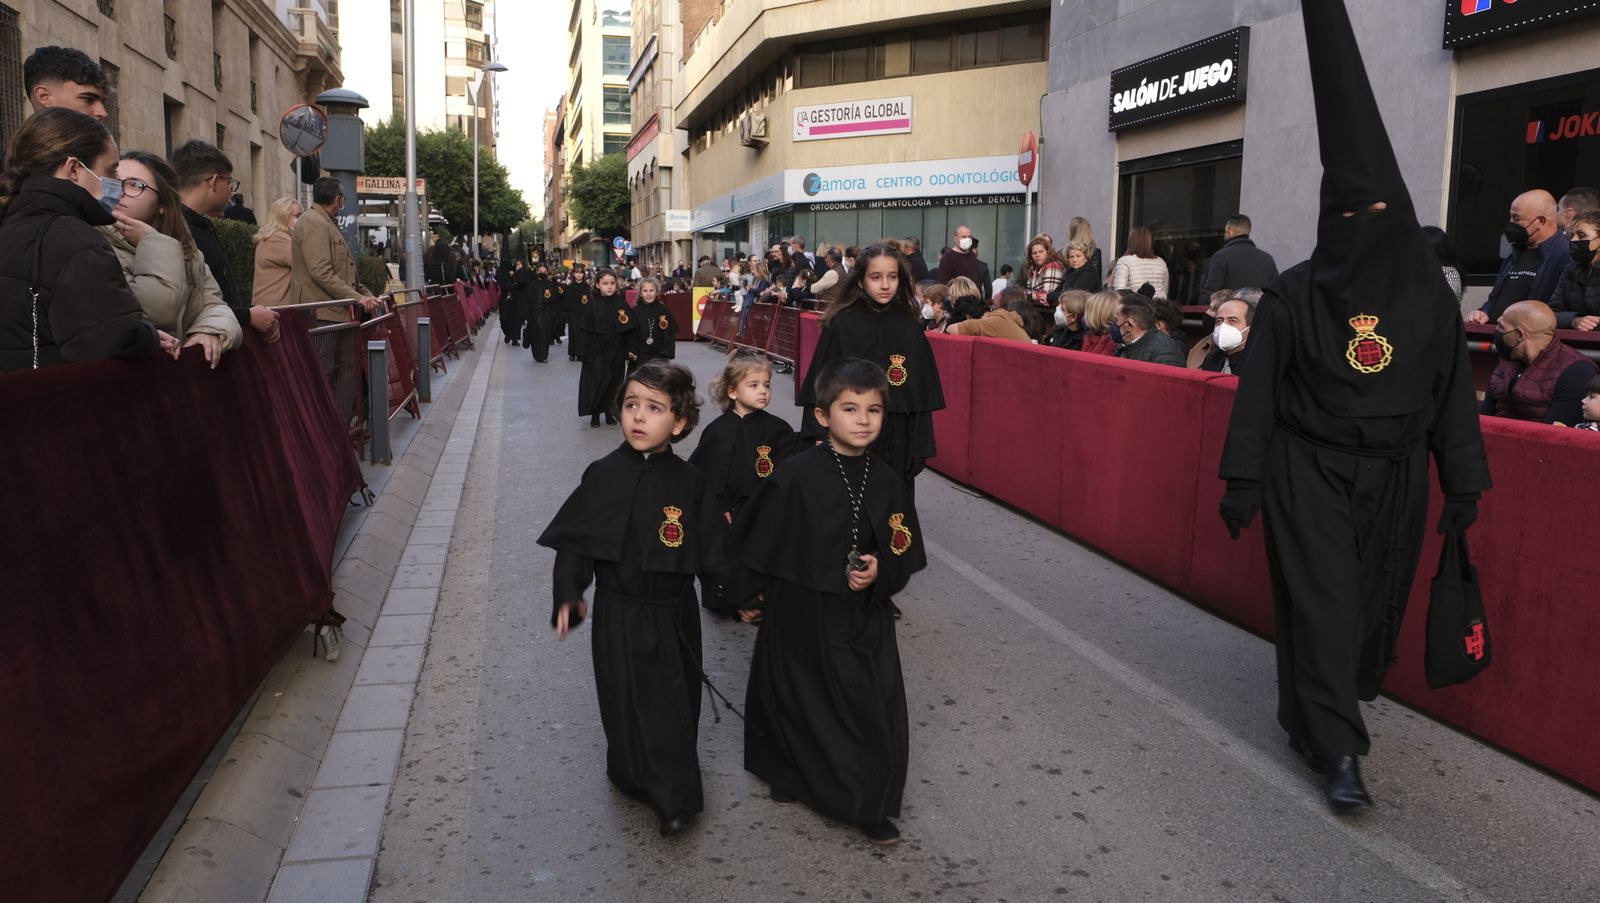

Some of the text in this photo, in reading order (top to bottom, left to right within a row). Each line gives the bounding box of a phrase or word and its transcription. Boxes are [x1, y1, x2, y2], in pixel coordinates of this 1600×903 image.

[1113, 59, 1233, 113] SALÓN DE JUEGO
[810, 103, 861, 123] GESTORÍA
[864, 102, 907, 118] GLOBAL
[365, 178, 401, 189] GALLINA
[809, 168, 1019, 193] Zamora CENTRO ODONTOLÓGIC
[810, 202, 857, 211] ORTODONCIA
[988, 195, 1021, 204] DENTAL
